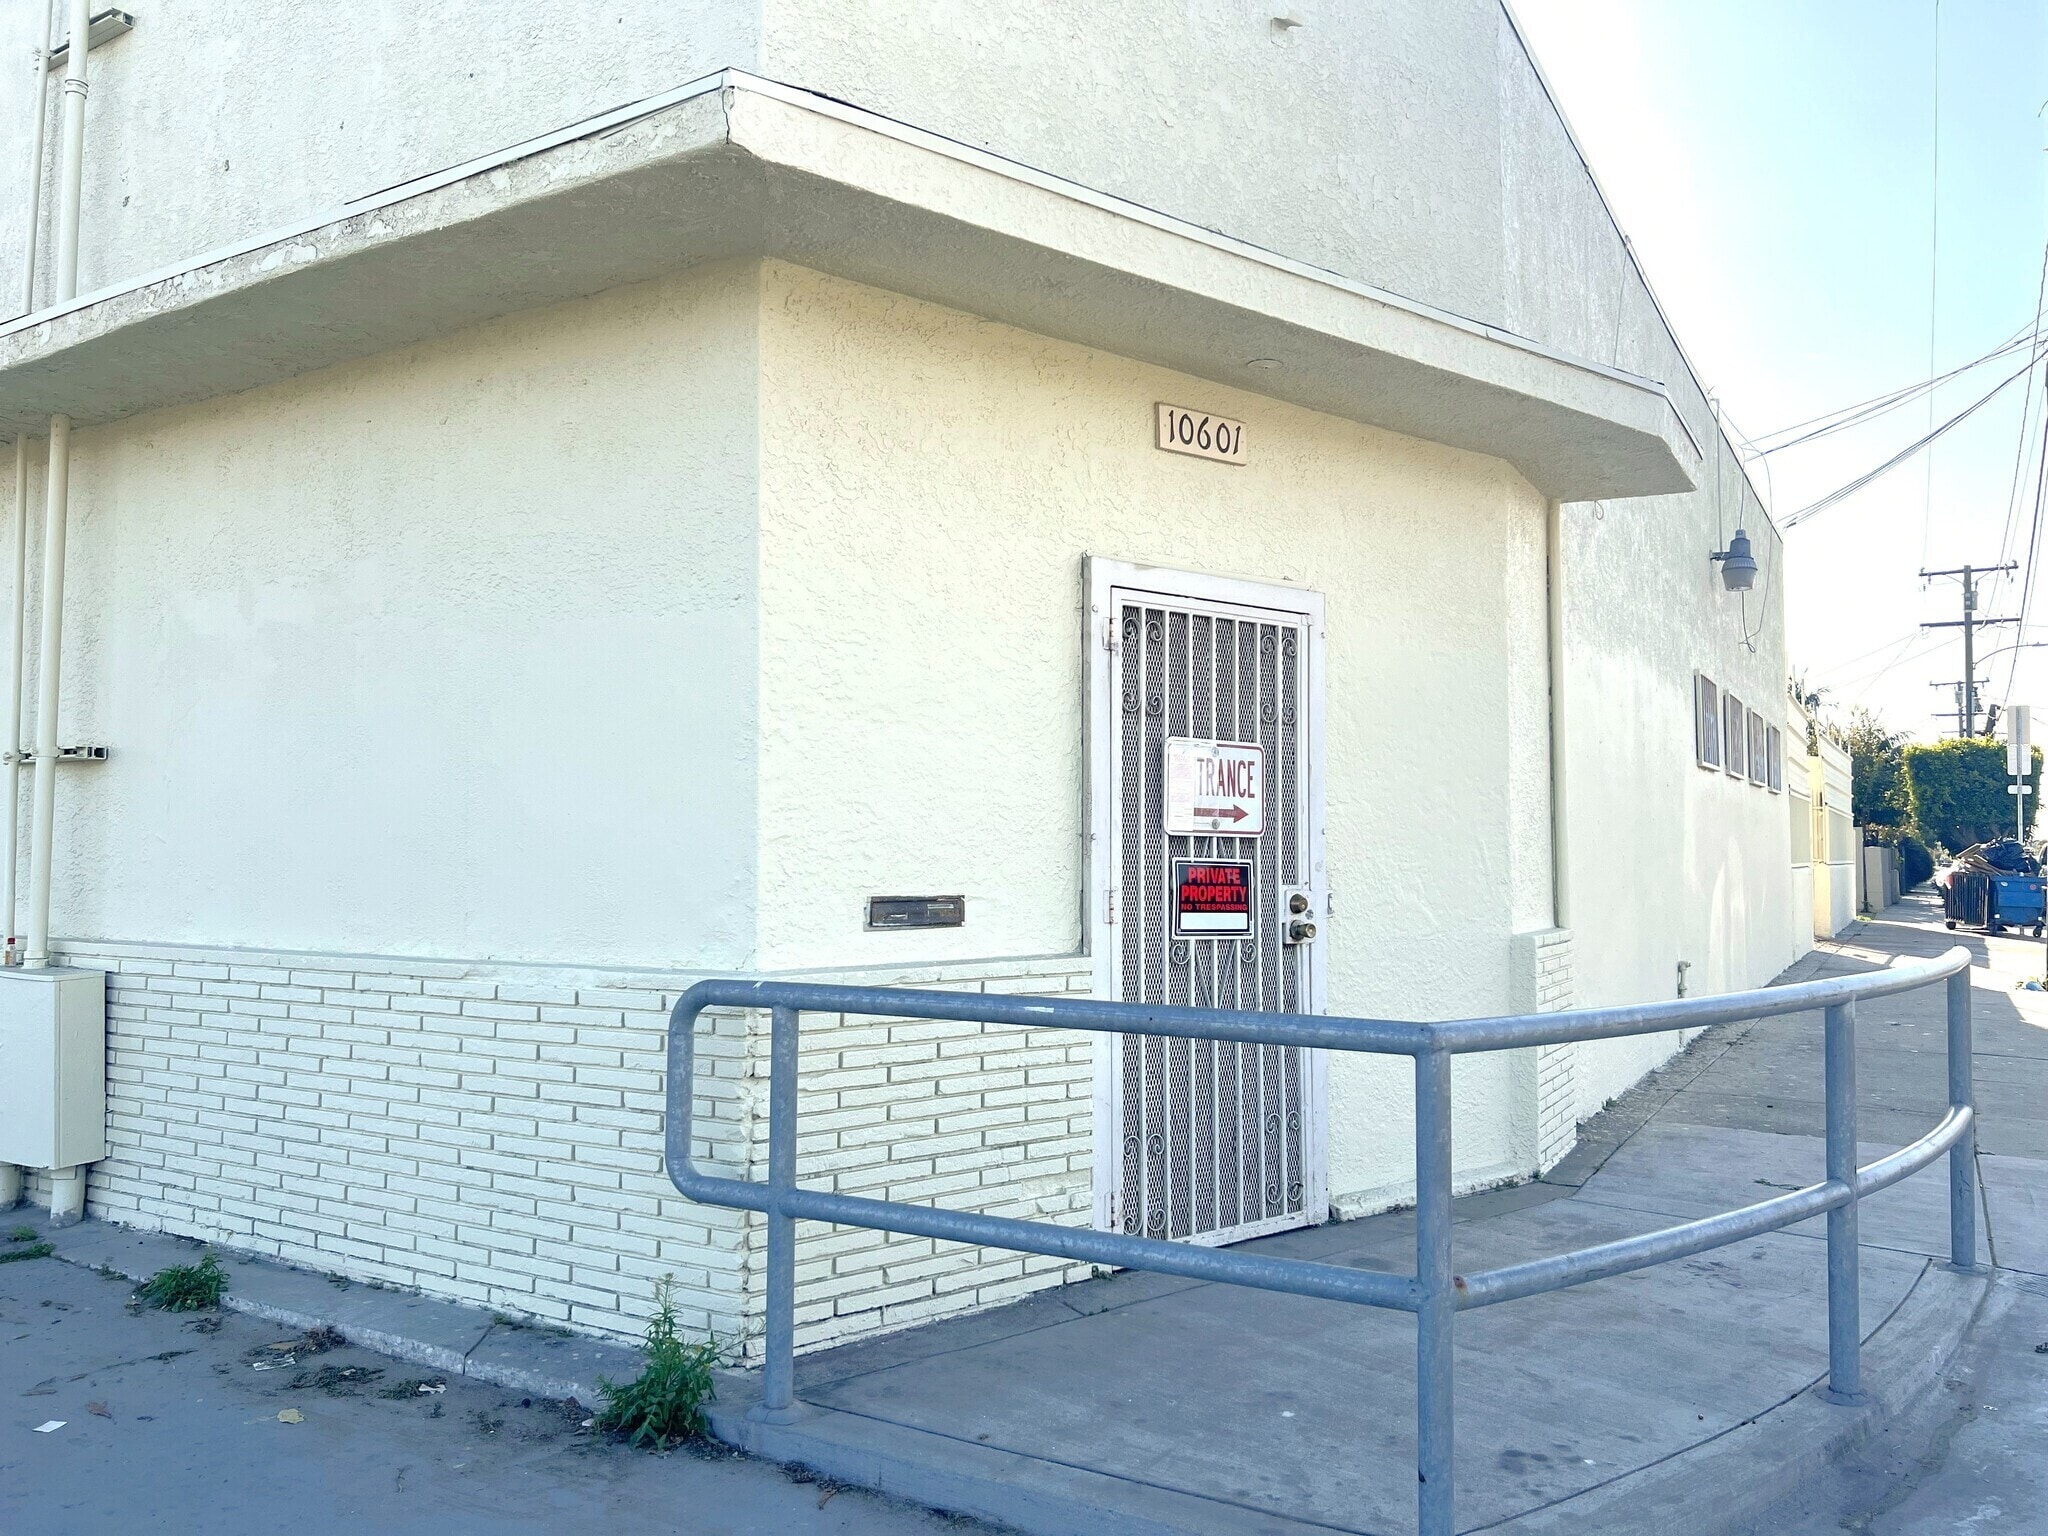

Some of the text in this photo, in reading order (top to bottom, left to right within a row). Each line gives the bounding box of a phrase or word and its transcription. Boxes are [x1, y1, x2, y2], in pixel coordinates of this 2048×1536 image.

[1168, 409, 1242, 455] 10601
[1197, 757, 1255, 798] TRANCE
[1188, 867, 1241, 885] PRIVATE
[1181, 885, 1247, 902] PROPERTY
[1181, 903, 1248, 911] NO TRESPASSING
